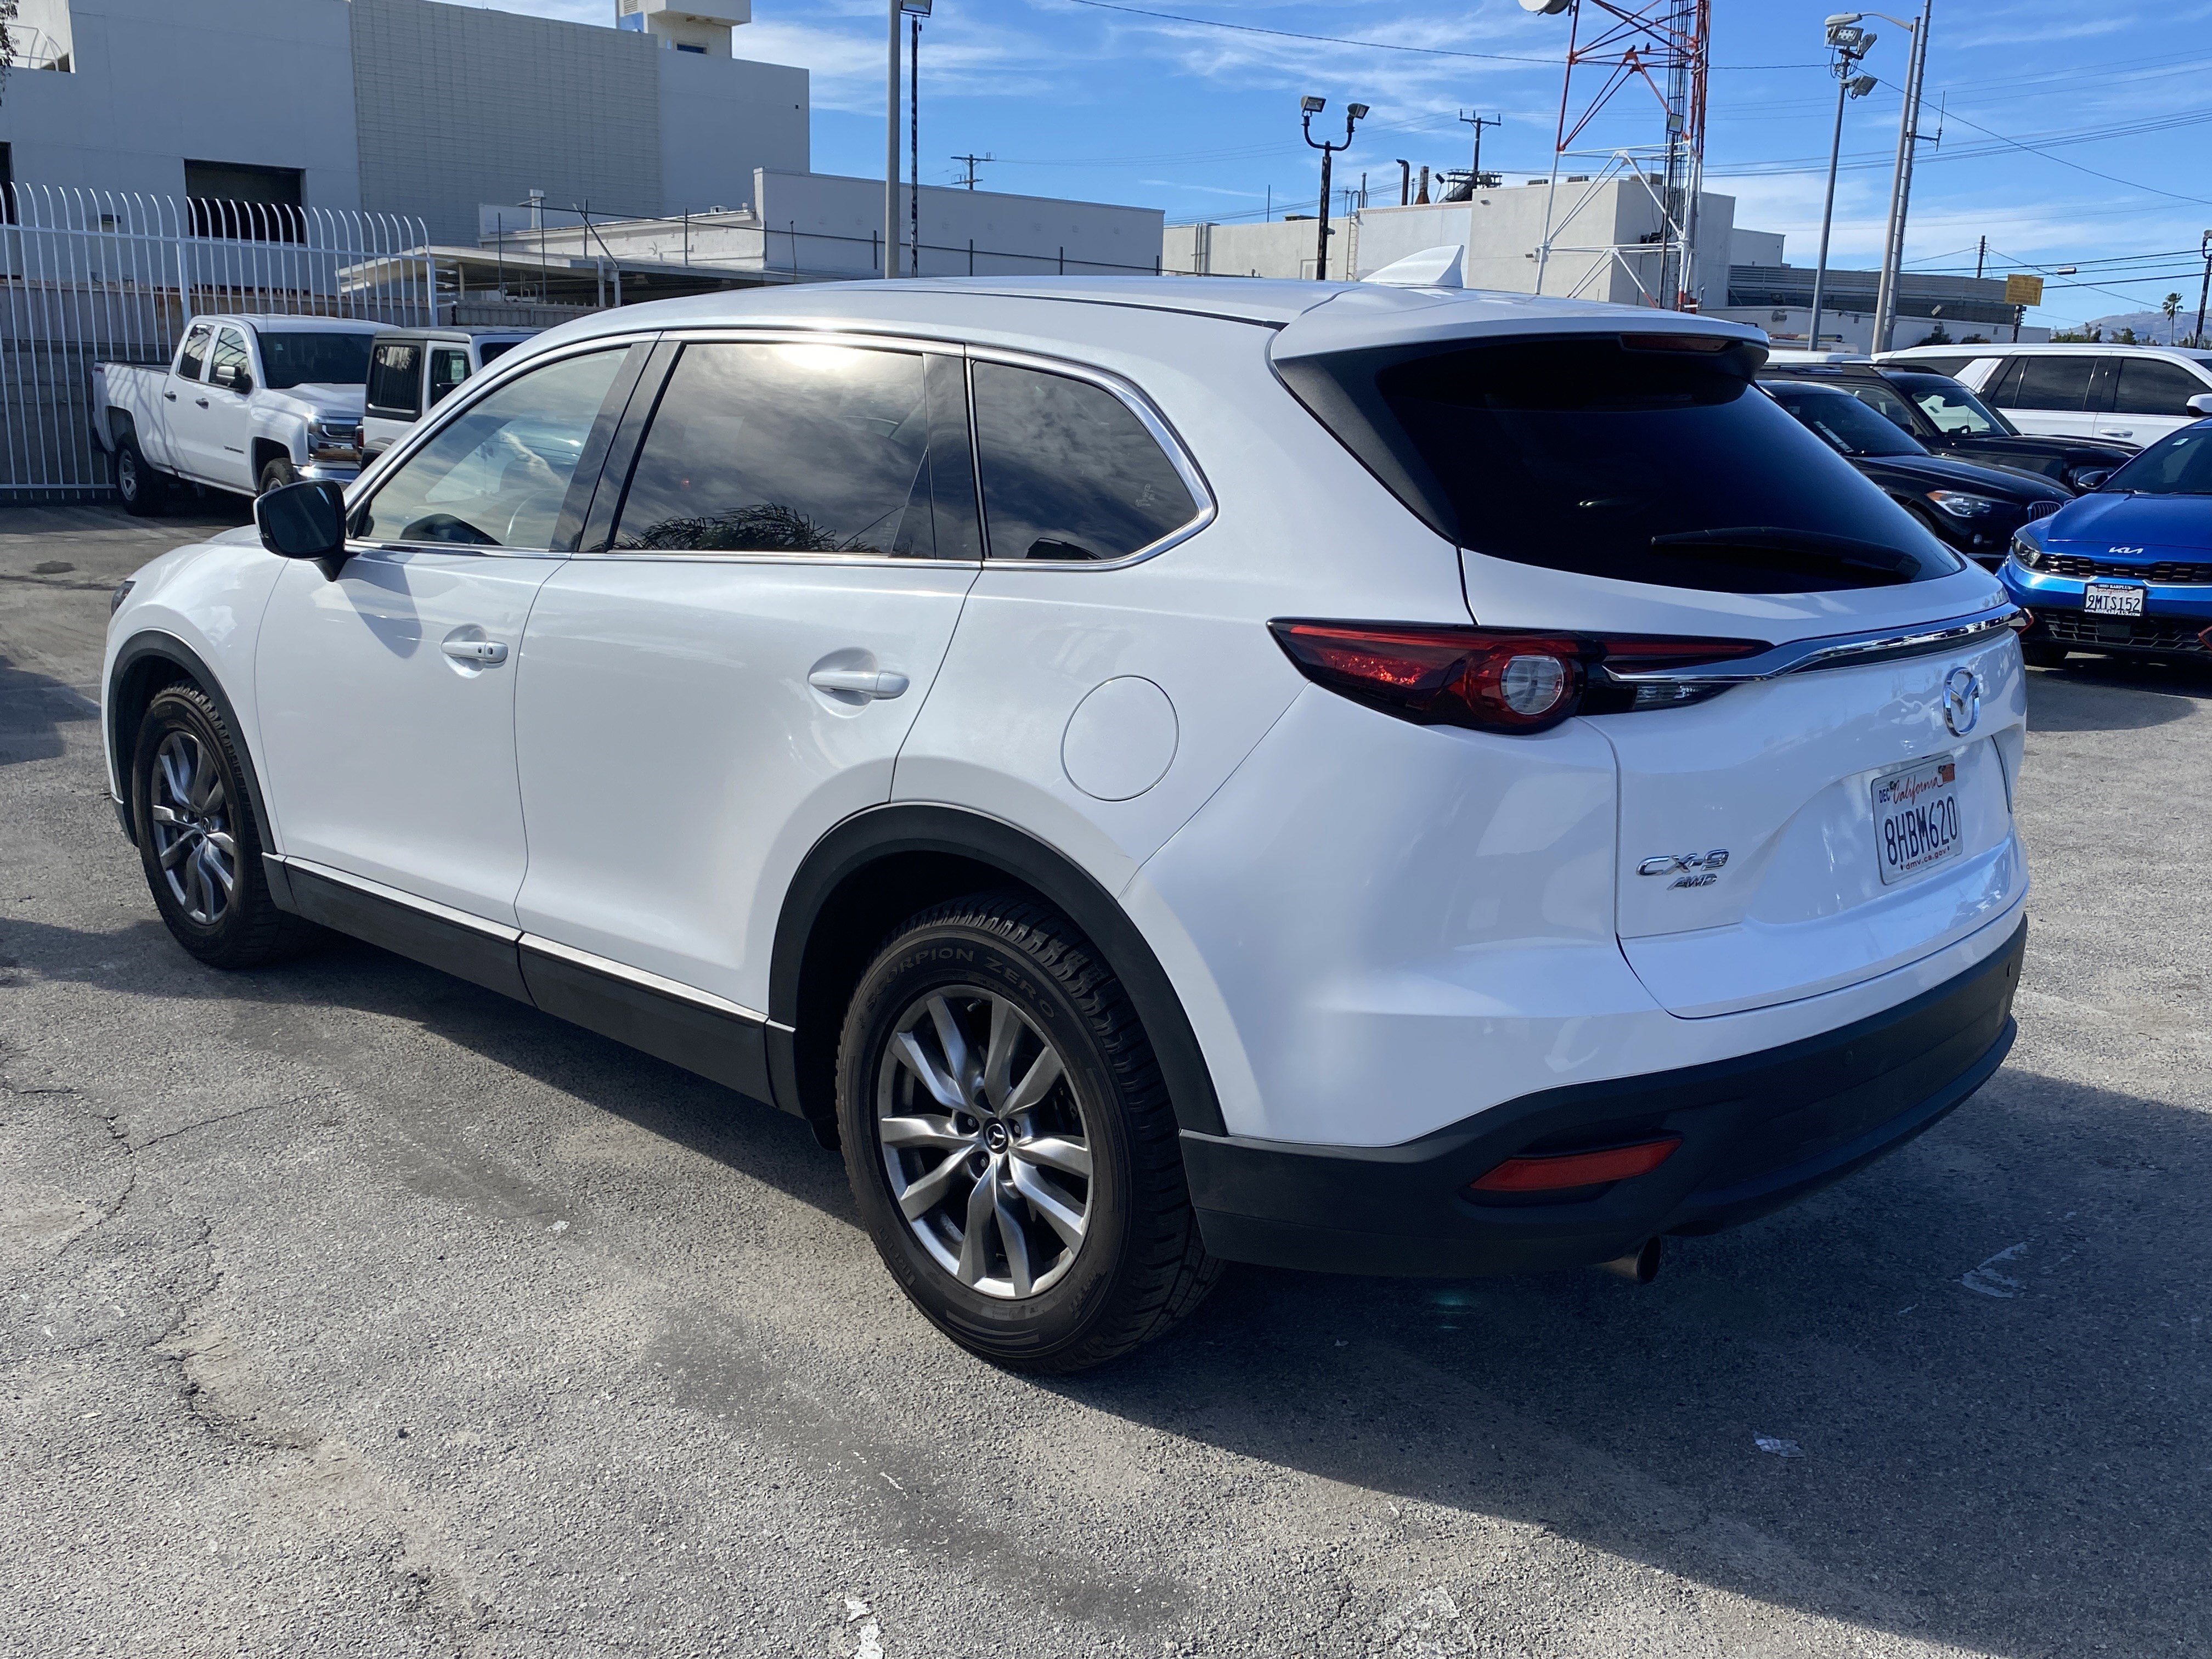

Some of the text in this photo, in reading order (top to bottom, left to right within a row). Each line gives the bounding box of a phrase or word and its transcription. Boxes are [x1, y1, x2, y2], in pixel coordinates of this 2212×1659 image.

[2088, 595, 2140, 614] 9MTS152
[1878, 774, 1944, 806] DEC California
[1884, 795, 1957, 866] 8HBM620
[1635, 849, 1730, 876] CX-9
[1905, 848, 1947, 870] dmv.ca.gov
[1666, 873, 1718, 891] AWD
[866, 947, 974, 1013] SCORPION
[984, 955, 1056, 1018] ZERO
